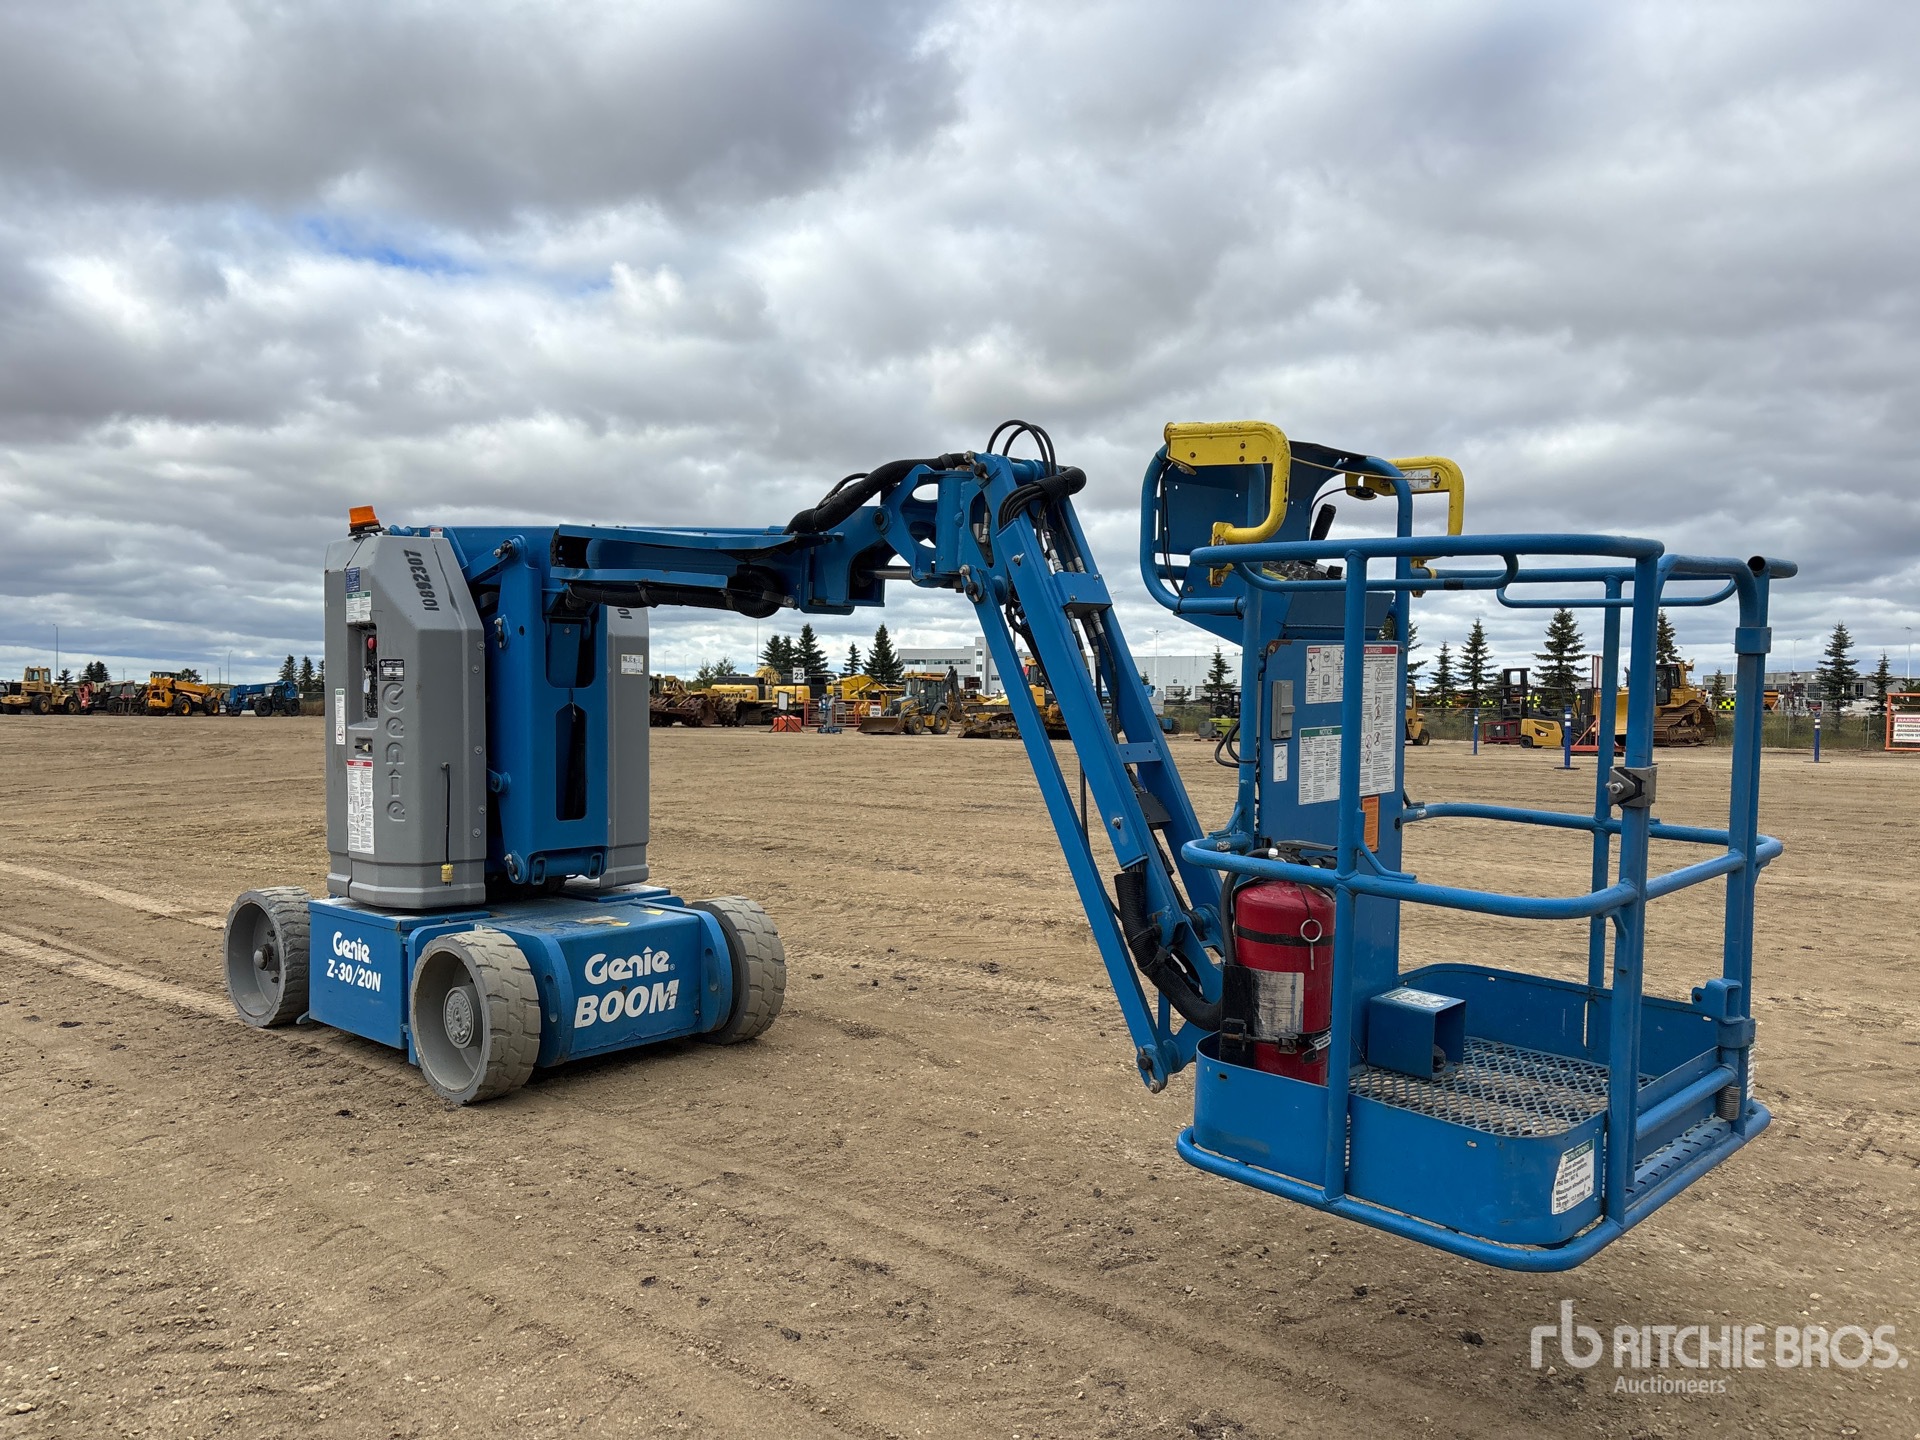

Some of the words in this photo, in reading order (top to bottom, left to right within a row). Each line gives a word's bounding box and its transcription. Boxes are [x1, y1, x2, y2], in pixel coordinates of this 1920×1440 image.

[403, 549, 440, 612] 10892307
[794, 672, 804, 680] 23
[332, 931, 372, 964] Genie
[584, 946, 671, 985] Genie
[326, 959, 382, 992] Z-30/20N
[574, 979, 680, 1029] BOOM
